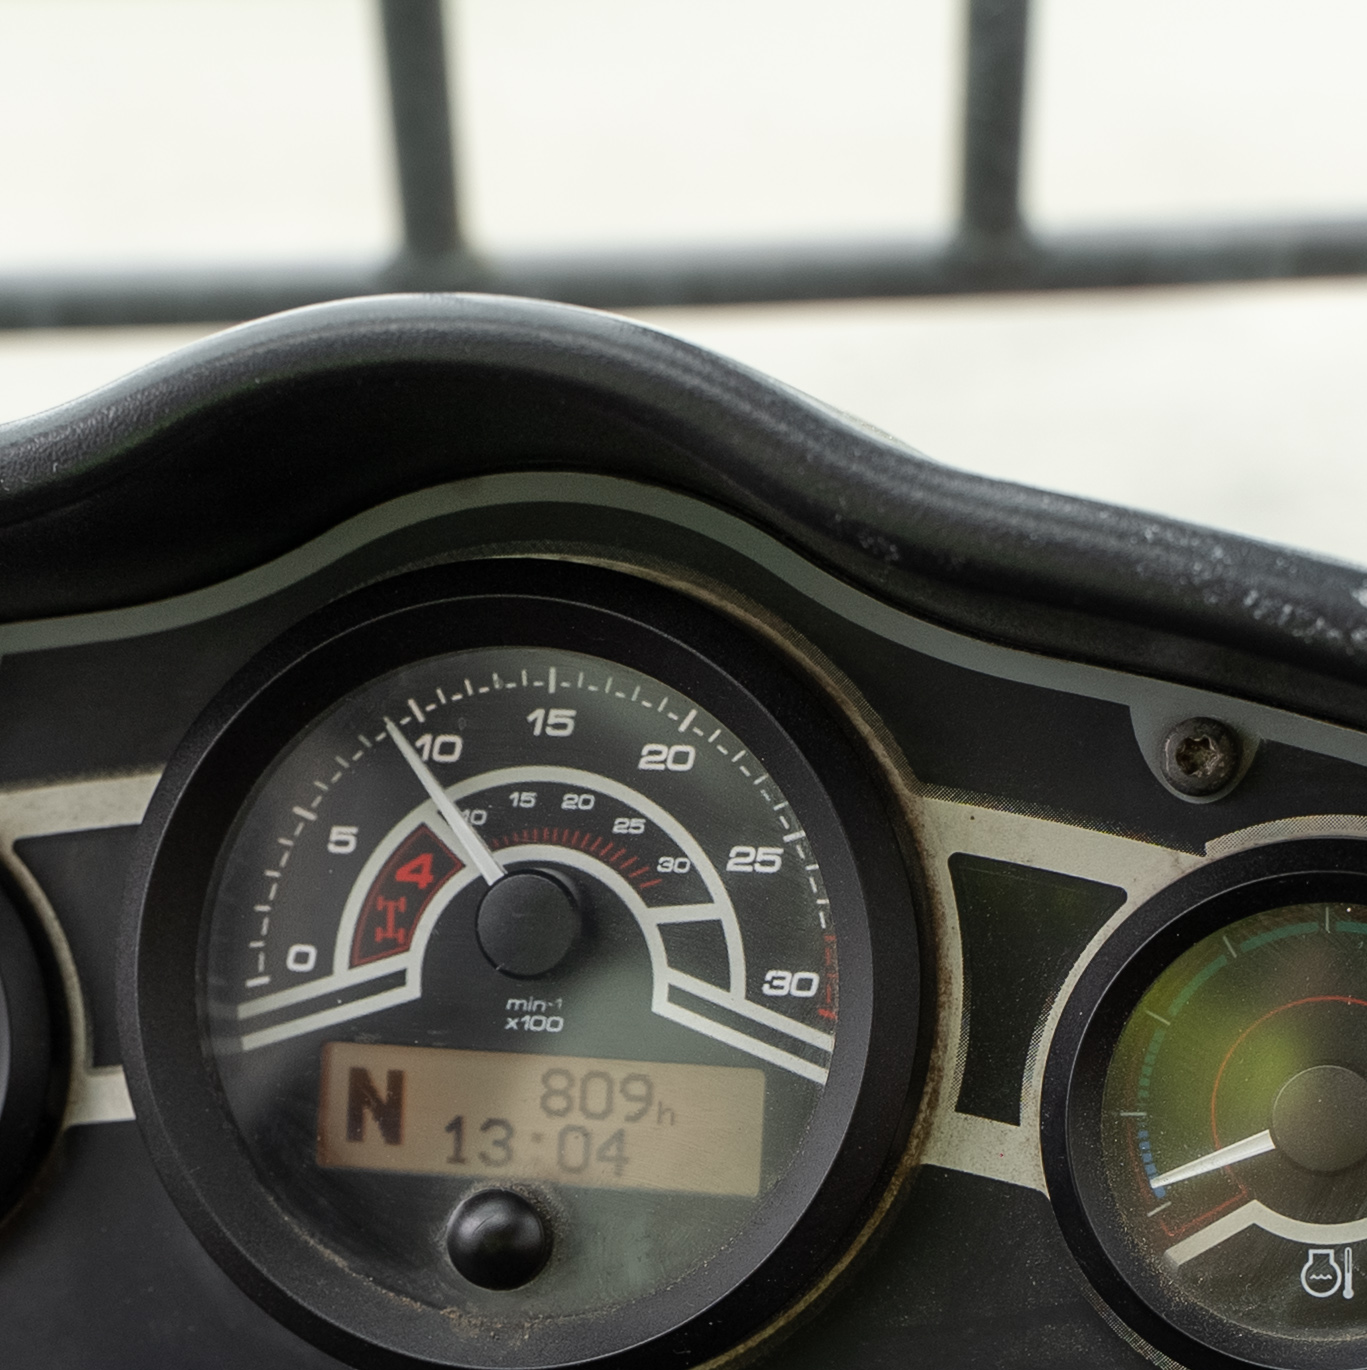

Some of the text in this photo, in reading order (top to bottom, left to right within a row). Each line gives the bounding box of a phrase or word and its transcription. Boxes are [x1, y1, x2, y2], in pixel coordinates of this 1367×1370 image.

[527, 708, 576, 738] 15
[414, 734, 462, 763] 10
[639, 744, 696, 772] 20
[508, 792, 537, 809] 15
[561, 793, 595, 810] 20
[328, 826, 358, 853] 5
[612, 818, 645, 835] 25
[395, 852, 434, 890] 4
[657, 856, 692, 875] 30
[727, 846, 783, 874] 25
[287, 944, 316, 972] 0
[762, 970, 820, 998] 30
[505, 1015, 564, 1033] x100
[346, 1066, 406, 1146] N
[444, 1114, 630, 1176] 13:04
